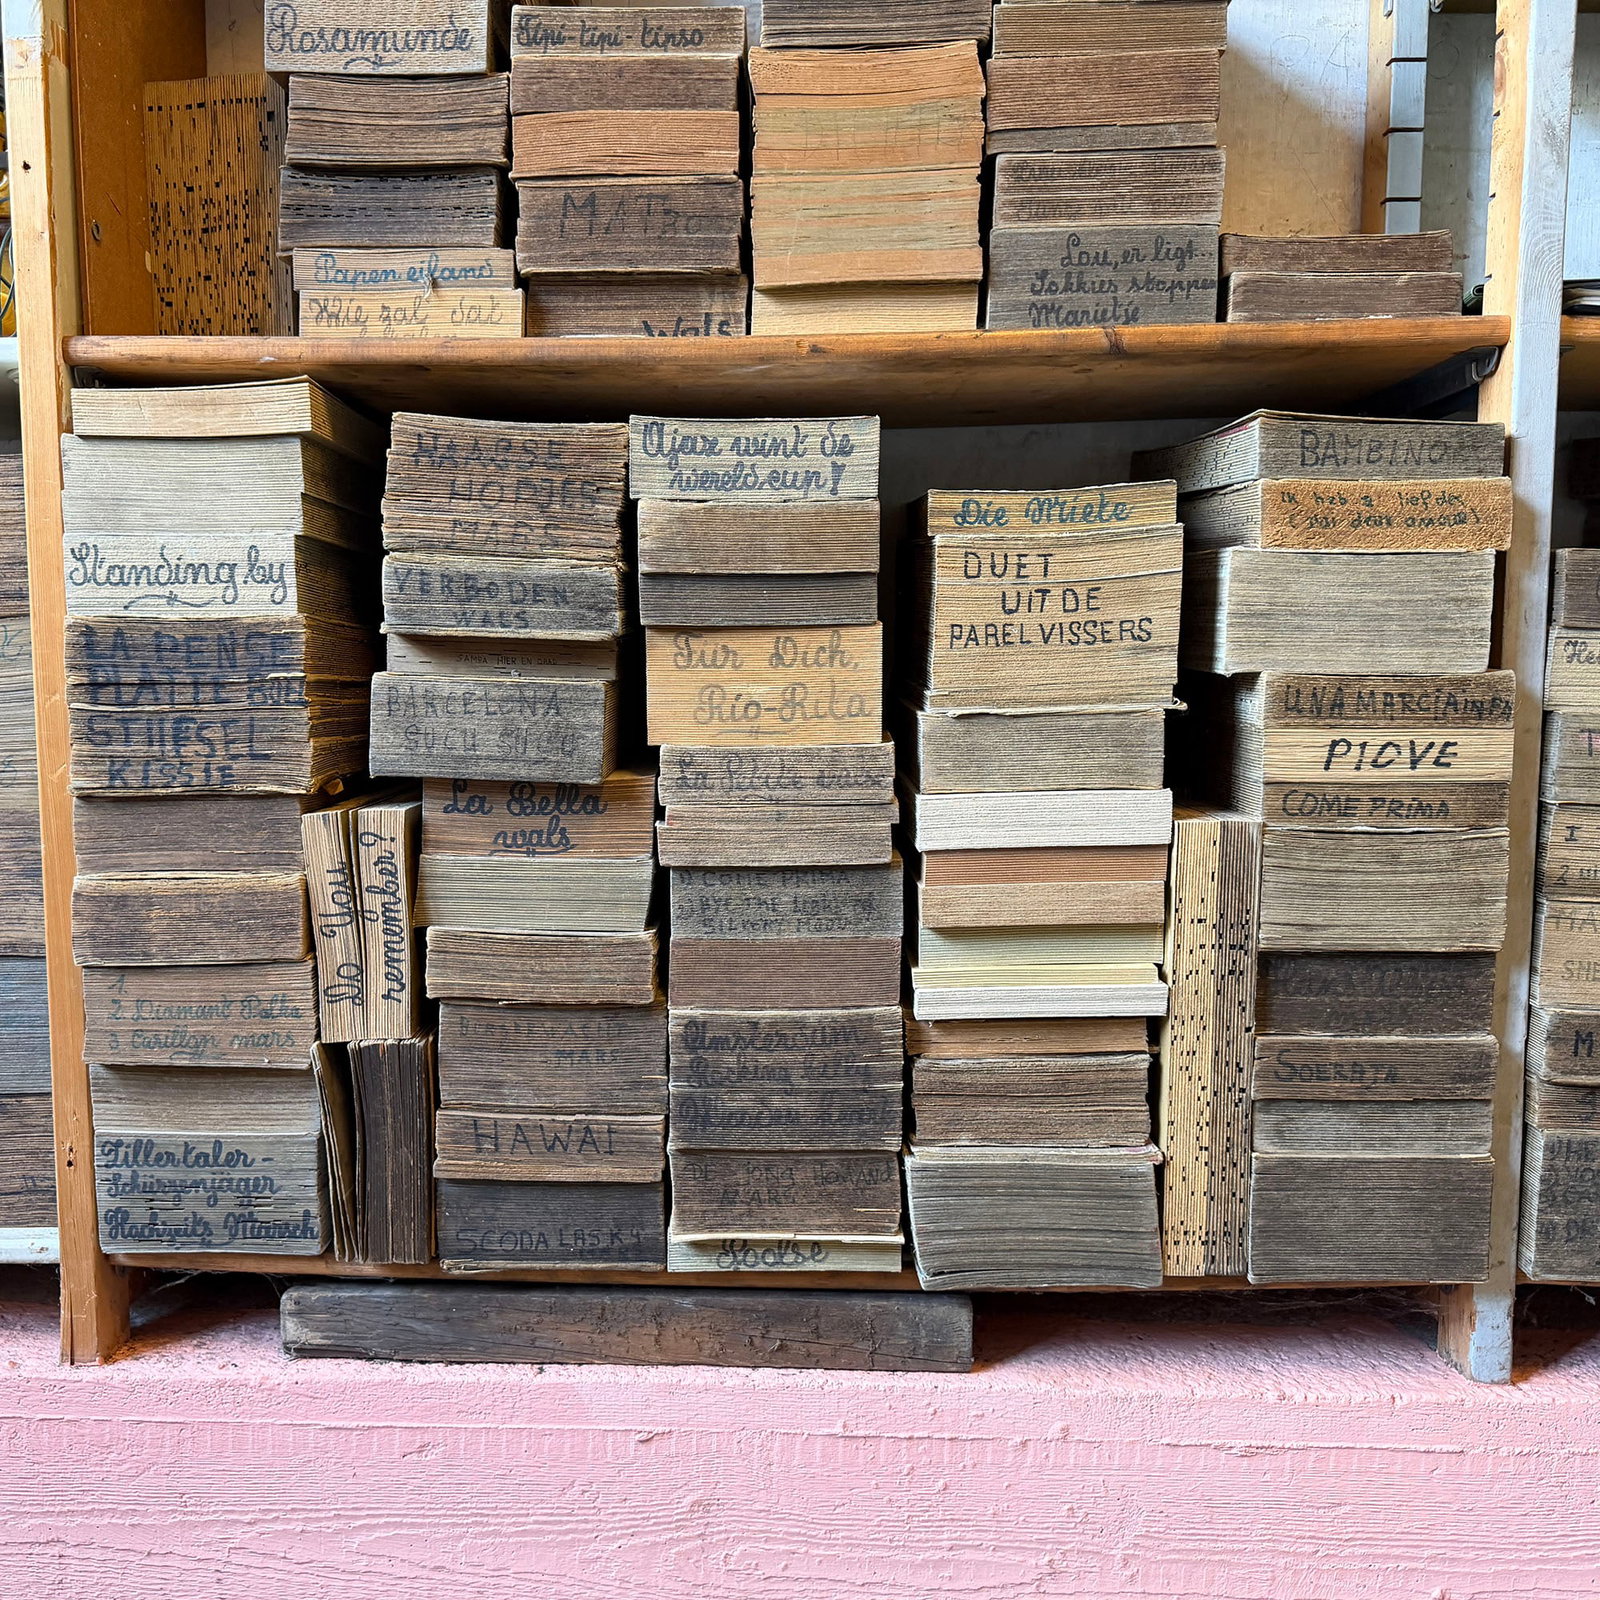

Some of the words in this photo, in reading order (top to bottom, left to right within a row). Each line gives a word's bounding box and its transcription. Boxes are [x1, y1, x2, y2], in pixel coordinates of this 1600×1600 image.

[267, 3, 474, 55] Rosamunde
[308, 296, 369, 327] Wie
[379, 295, 428, 327] zal
[451, 295, 504, 327] dat
[1029, 296, 1140, 328] Marietje
[642, 421, 722, 470] Ajax
[729, 425, 809, 460] wint
[820, 421, 855, 459] de
[1300, 429, 1447, 468] BAMBINO
[953, 498, 1010, 527] Die
[69, 542, 239, 606] Standing
[242, 544, 289, 606] by
[963, 550, 1054, 579] DUET
[1001, 588, 1052, 615] UIT
[1062, 587, 1103, 613] DE
[387, 685, 562, 719] BARCELONA
[1283, 685, 1345, 717] UNA
[1323, 738, 1459, 771] PIOVE
[442, 778, 494, 815] La
[506, 780, 609, 817] Bella
[1282, 789, 1360, 817] COME
[1368, 797, 1450, 819] PRIMA
[491, 816, 576, 850] wals
[473, 1119, 618, 1155] HAWAI
